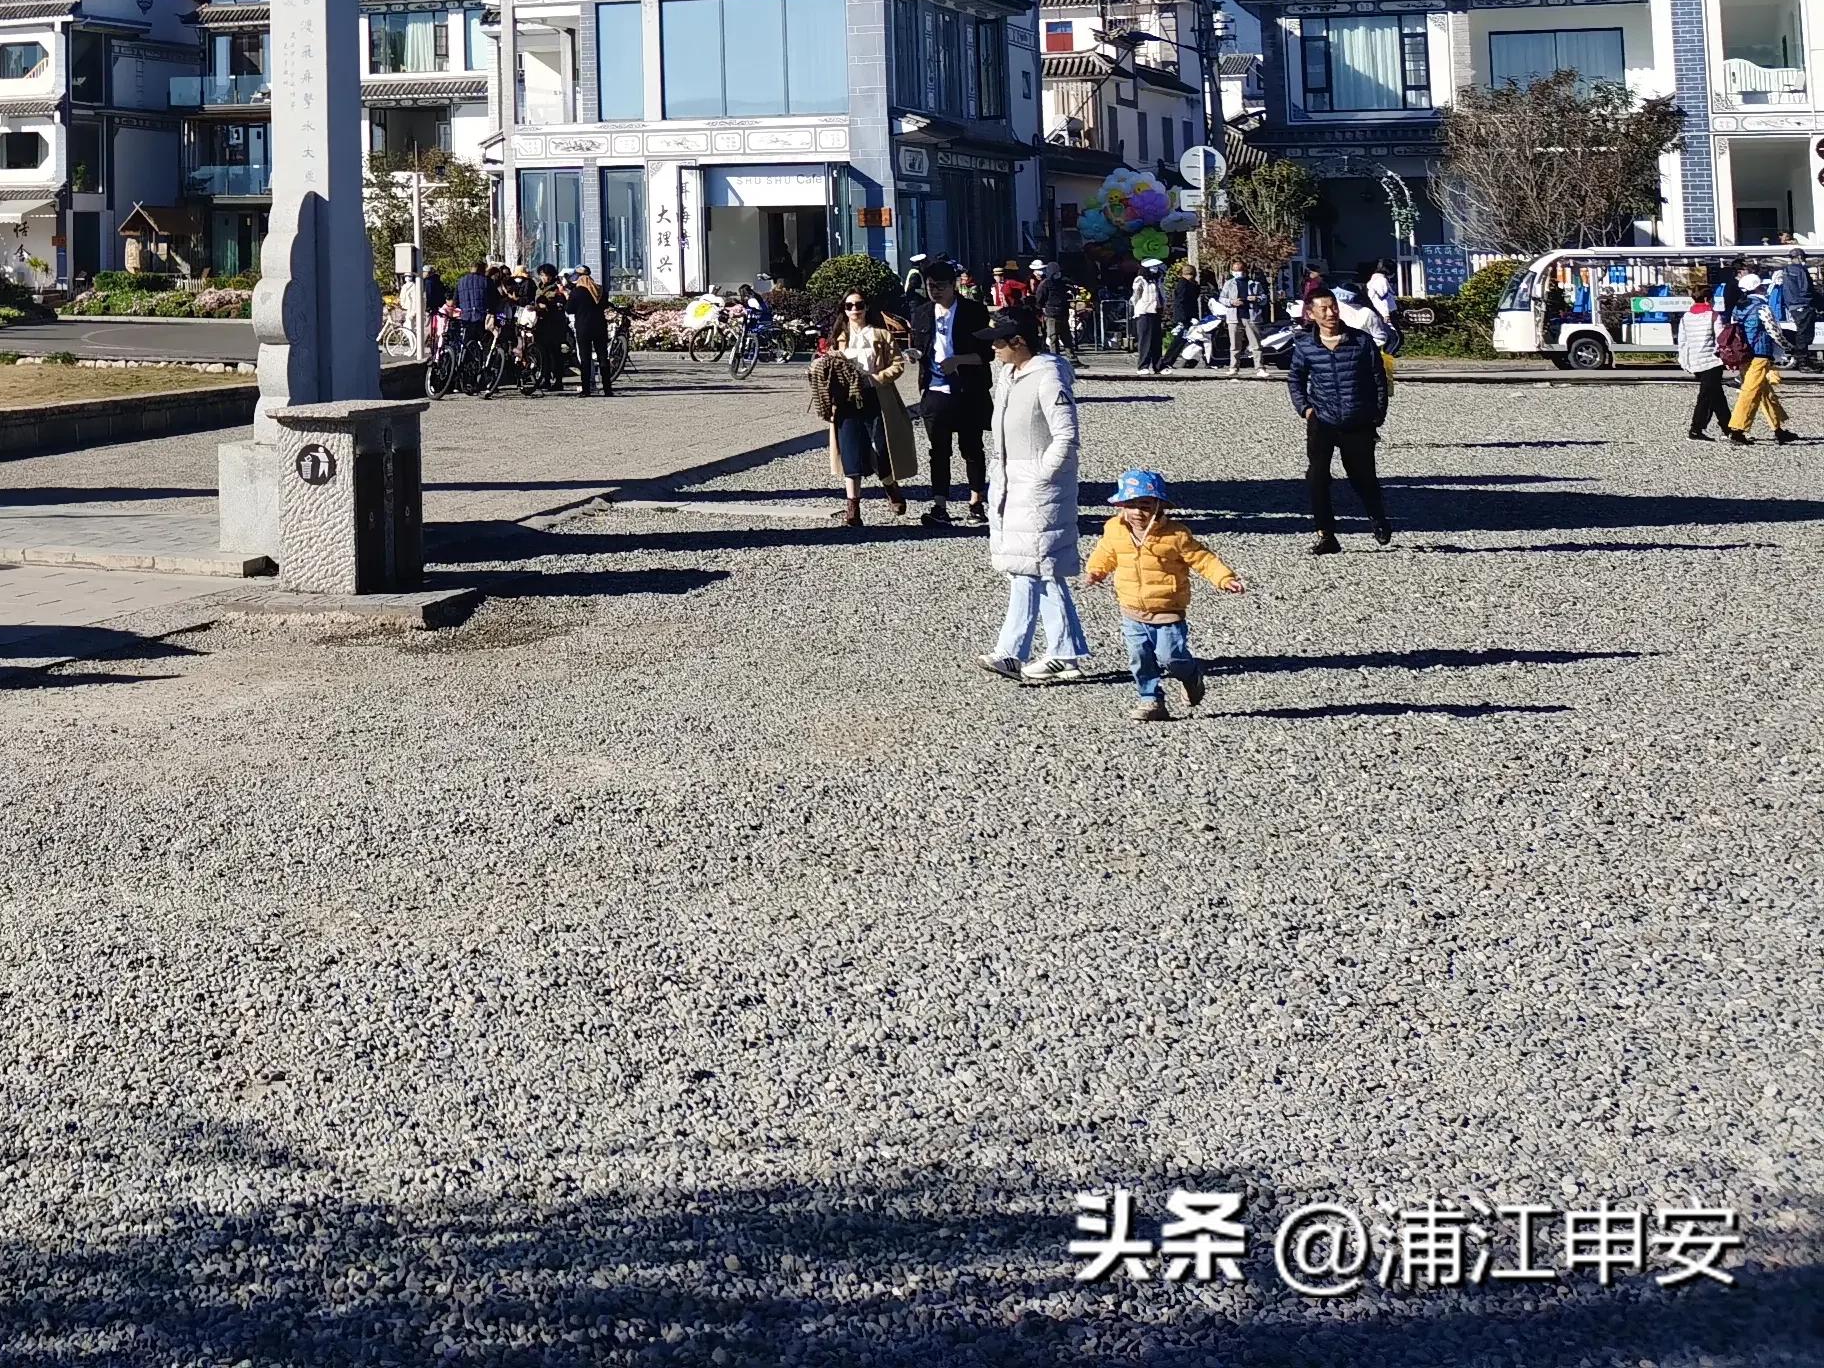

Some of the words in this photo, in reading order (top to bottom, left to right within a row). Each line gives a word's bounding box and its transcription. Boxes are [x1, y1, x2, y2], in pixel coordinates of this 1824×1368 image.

[736, 176, 762, 185] SHU
[766, 176, 792, 185] SHU
[796, 173, 823, 184] Cafe
[656, 204, 673, 273] 大理兴
